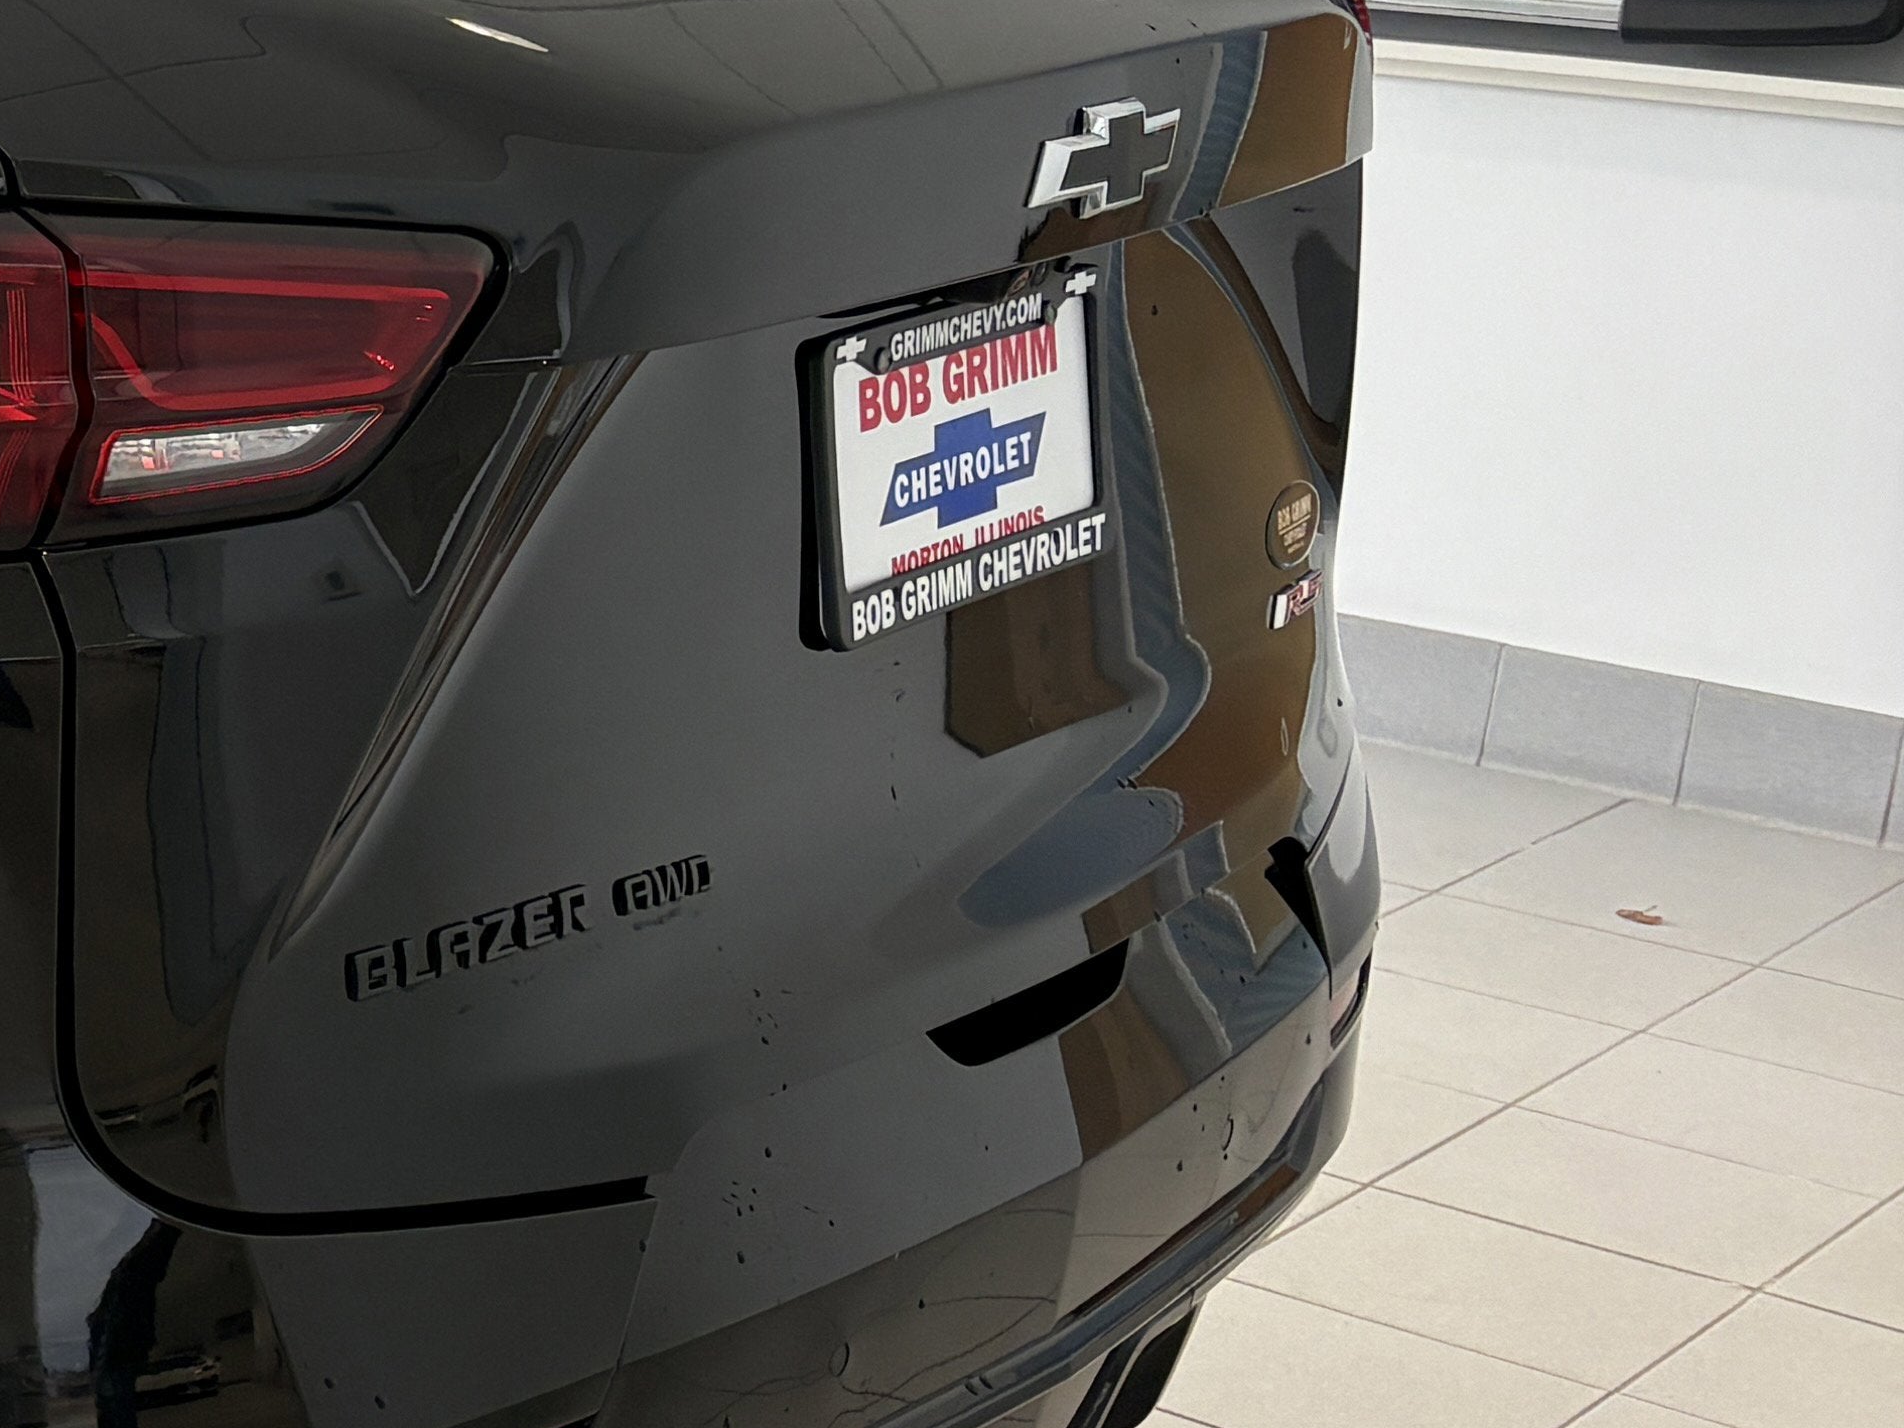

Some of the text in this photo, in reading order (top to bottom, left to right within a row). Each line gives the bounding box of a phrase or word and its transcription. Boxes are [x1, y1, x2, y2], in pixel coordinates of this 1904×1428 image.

[890, 293, 1042, 362] GRIMMCHEVY.COM
[858, 323, 1058, 433] BOB GRIMM
[894, 431, 1032, 508] CHEVROLET
[974, 505, 1046, 549] ILLINOIS
[852, 512, 1106, 641] BOB GRIMM CHEVROLET
[344, 854, 712, 1002] BLAZER AWD
